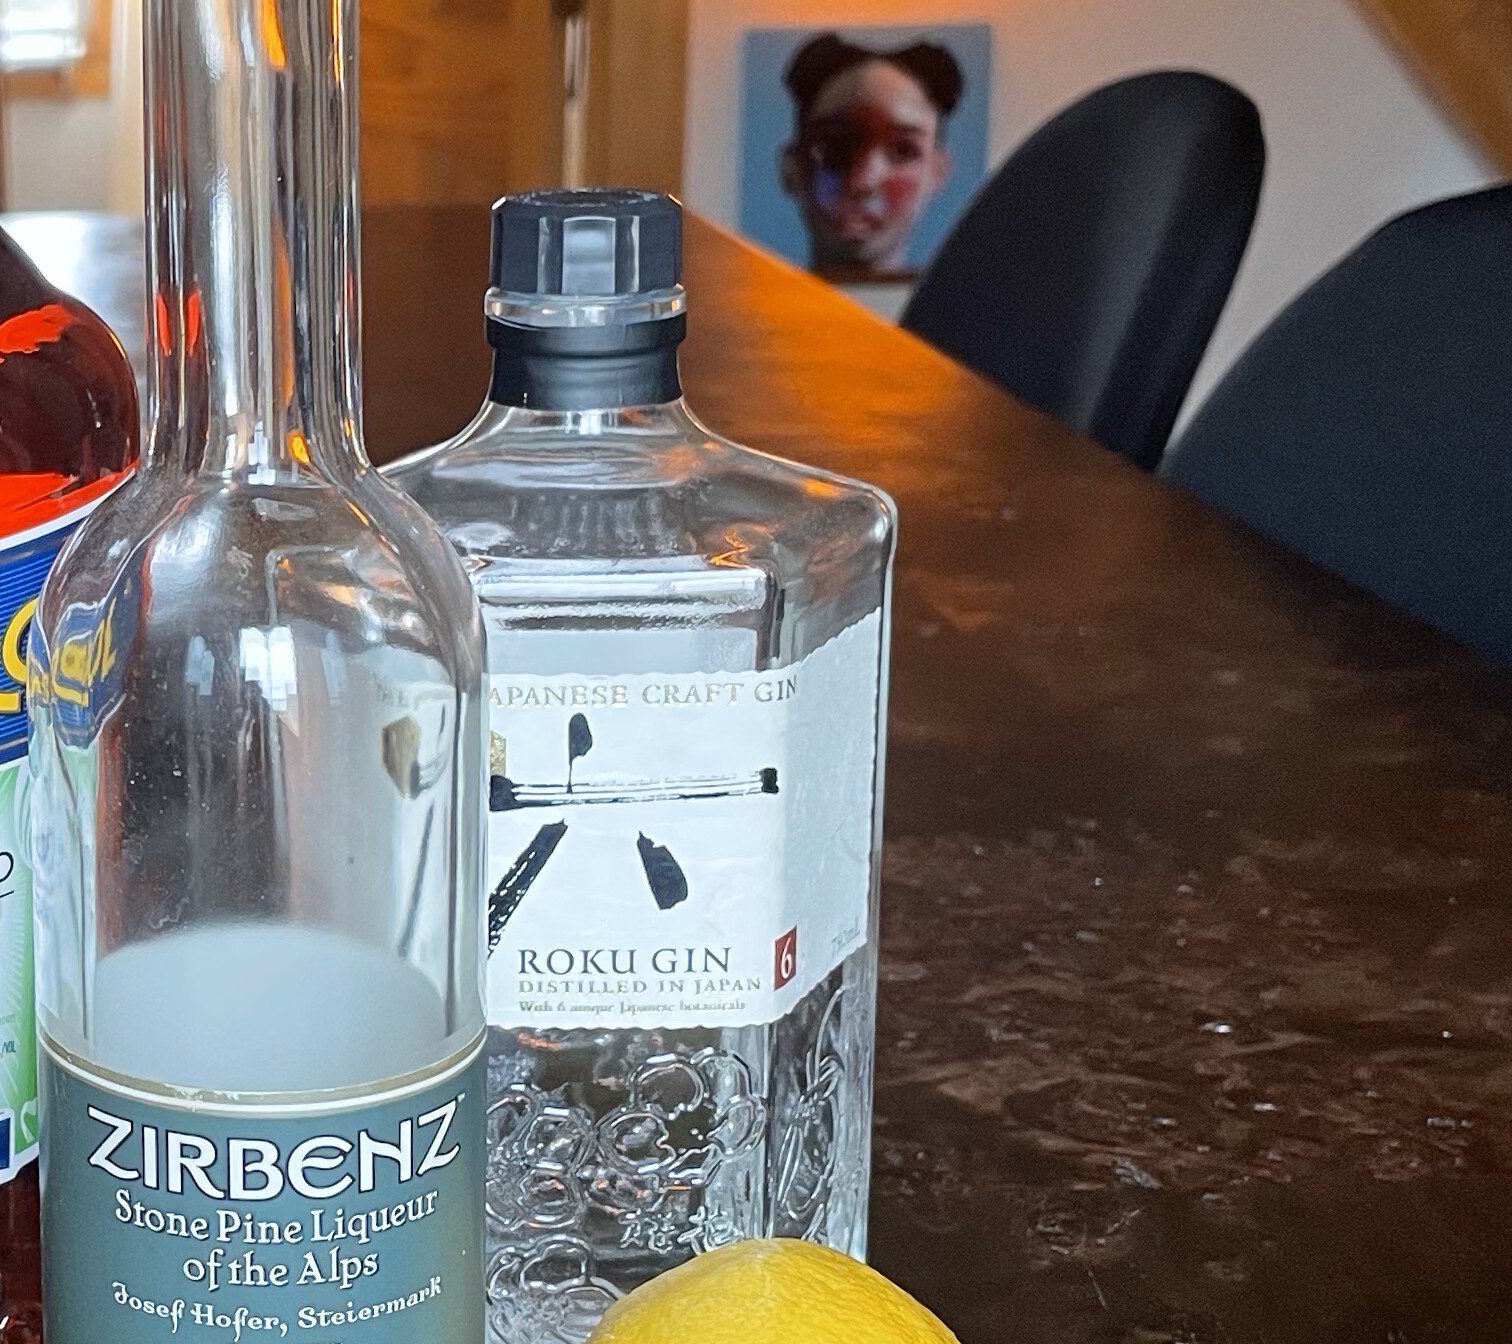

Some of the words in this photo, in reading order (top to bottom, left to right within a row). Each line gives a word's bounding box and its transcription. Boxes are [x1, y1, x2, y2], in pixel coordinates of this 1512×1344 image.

[488, 684, 630, 706] APANESE
[641, 682, 745, 705] CRAFT
[754, 675, 797, 703] GIN
[518, 948, 637, 975] ROKU
[651, 946, 731, 975] GIN
[518, 979, 647, 994] DISTILLED
[658, 979, 684, 994] IN
[695, 977, 762, 996] JAPAN
[87, 1096, 461, 1202] ZIRBENZ
[115, 1189, 210, 1241] Stone
[216, 1208, 304, 1245] Pine
[310, 1189, 439, 1245] Liqueur
[183, 1249, 224, 1291] of
[228, 1250, 289, 1287] the
[296, 1246, 378, 1290] Alps
[112, 1282, 185, 1334] Josef
[190, 1303, 289, 1343] Hofer,
[297, 1276, 442, 1329] Steiermark
